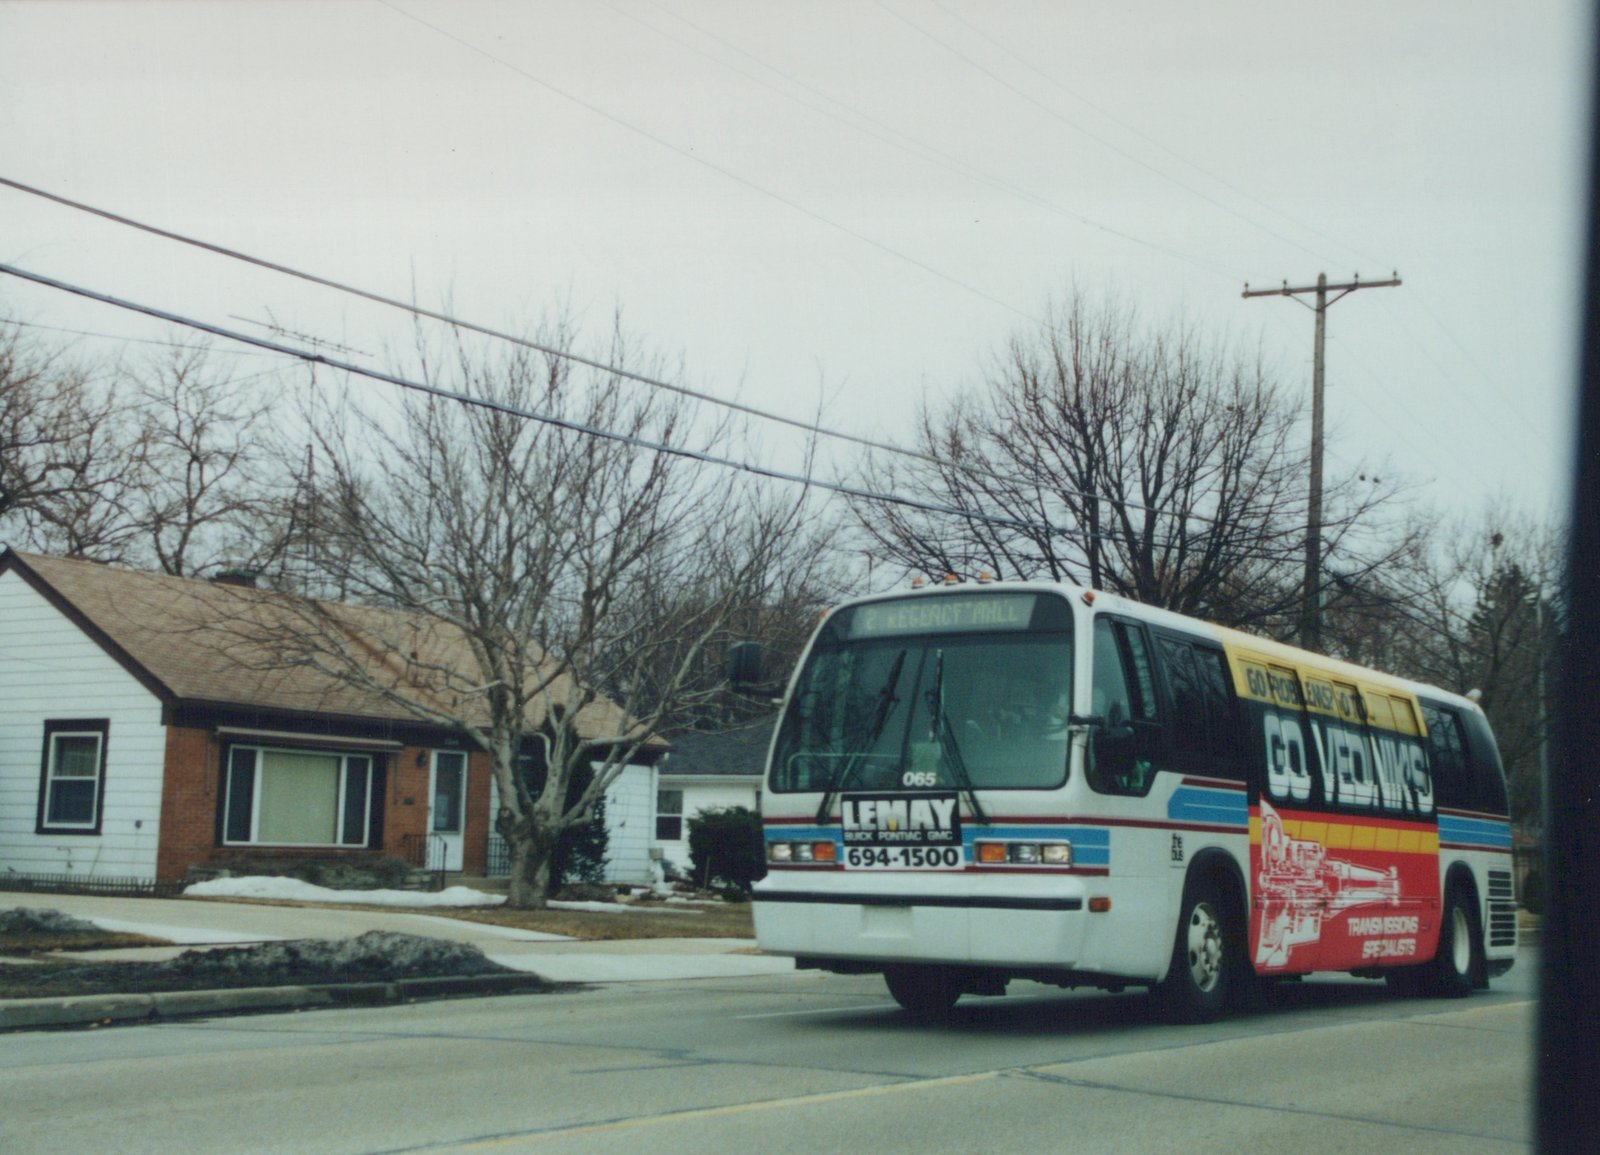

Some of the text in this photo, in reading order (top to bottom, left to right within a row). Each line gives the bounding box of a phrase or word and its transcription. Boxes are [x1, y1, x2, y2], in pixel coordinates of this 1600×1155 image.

[1263, 711, 1312, 799] GO
[902, 771, 936, 786] 065
[842, 799, 956, 831] LEMAY
[844, 831, 953, 841] BUICK PONTIAC GMC
[848, 847, 959, 867] 694-1500
